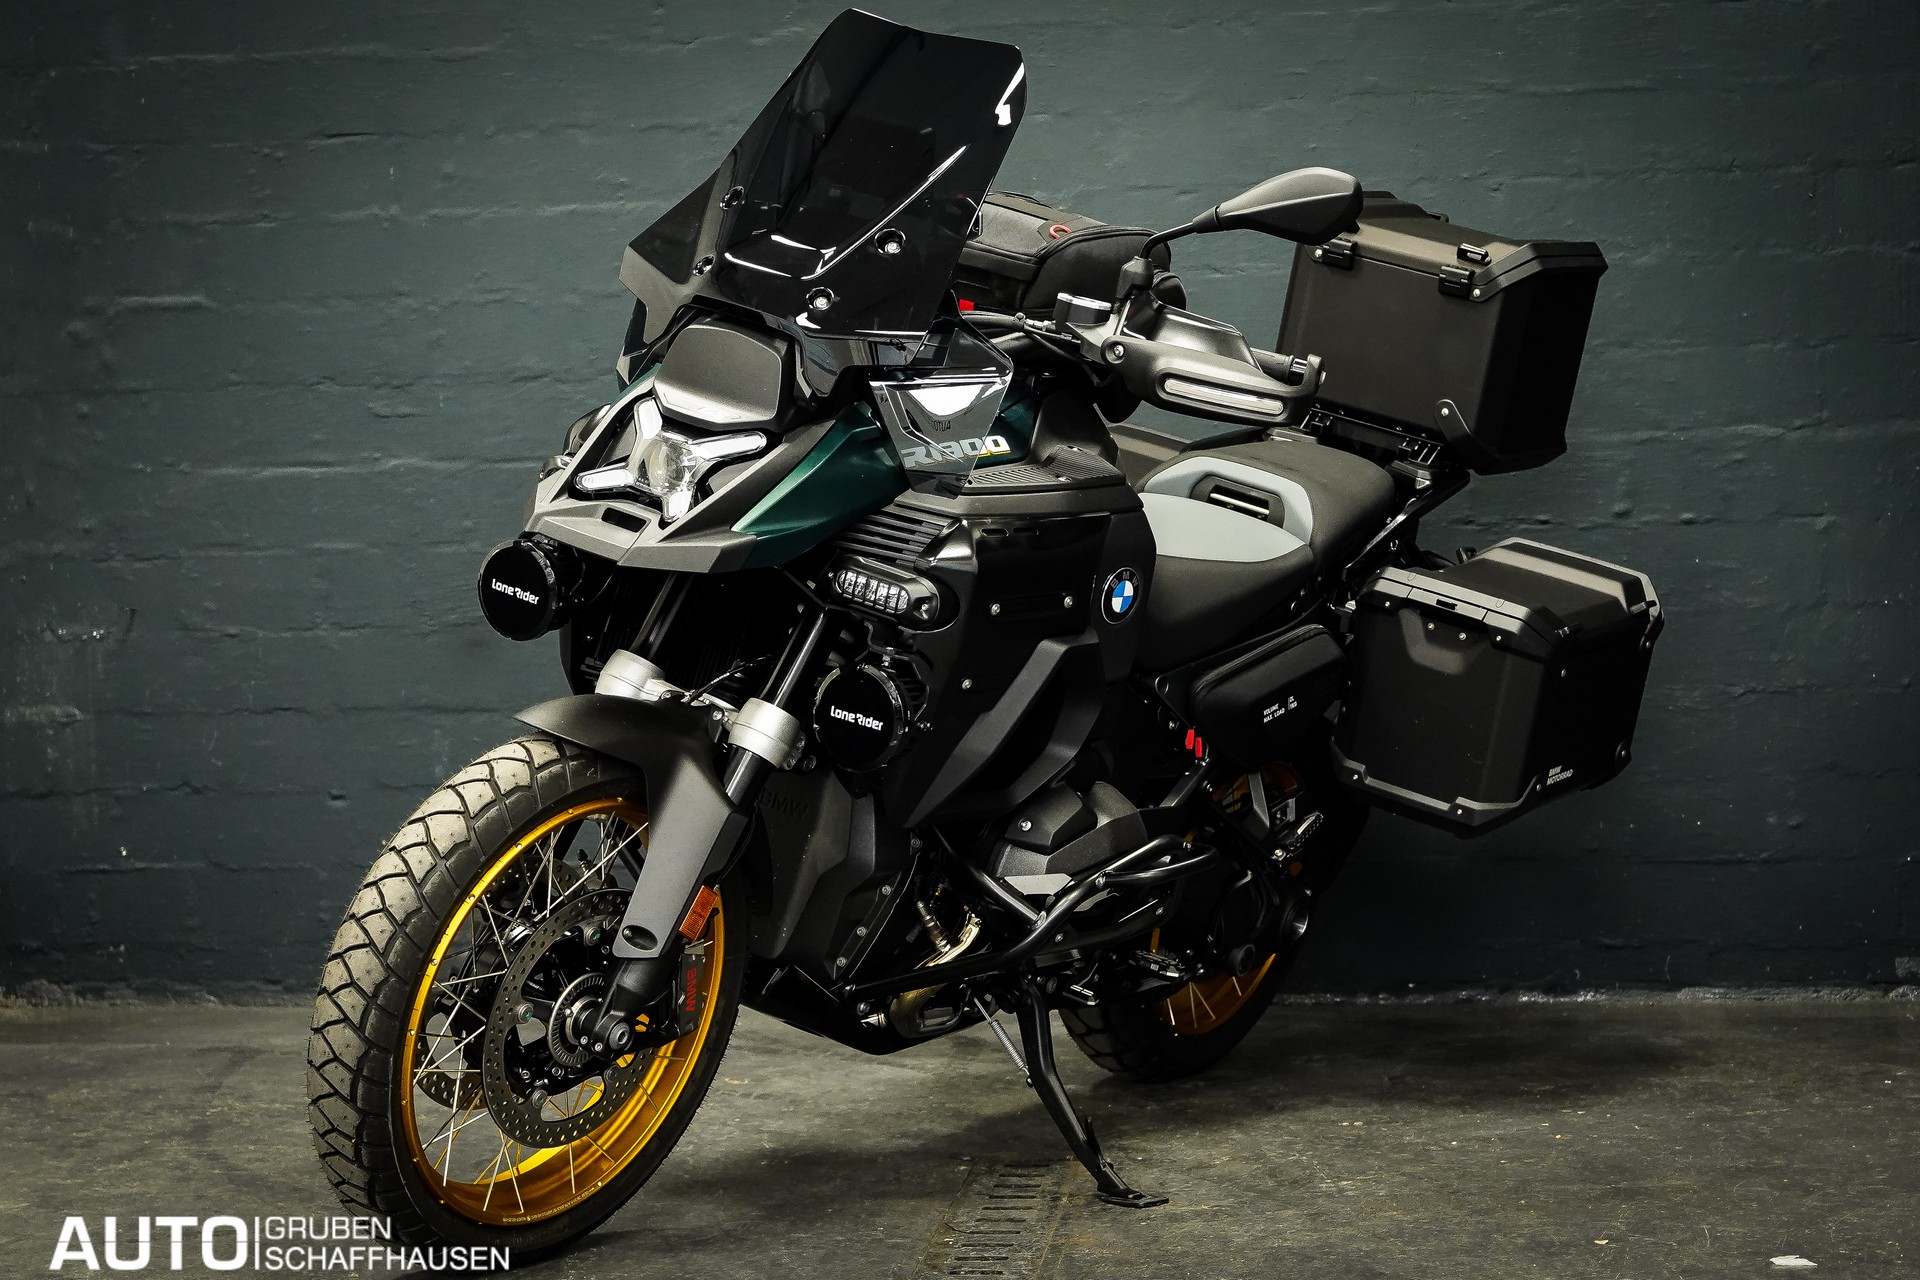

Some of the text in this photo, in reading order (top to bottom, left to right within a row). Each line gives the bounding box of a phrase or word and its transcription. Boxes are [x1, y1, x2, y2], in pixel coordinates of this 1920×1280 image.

[1110, 570, 1139, 589] BMW
[759, 787, 809, 819] BMW
[685, 966, 698, 1012] BMW
